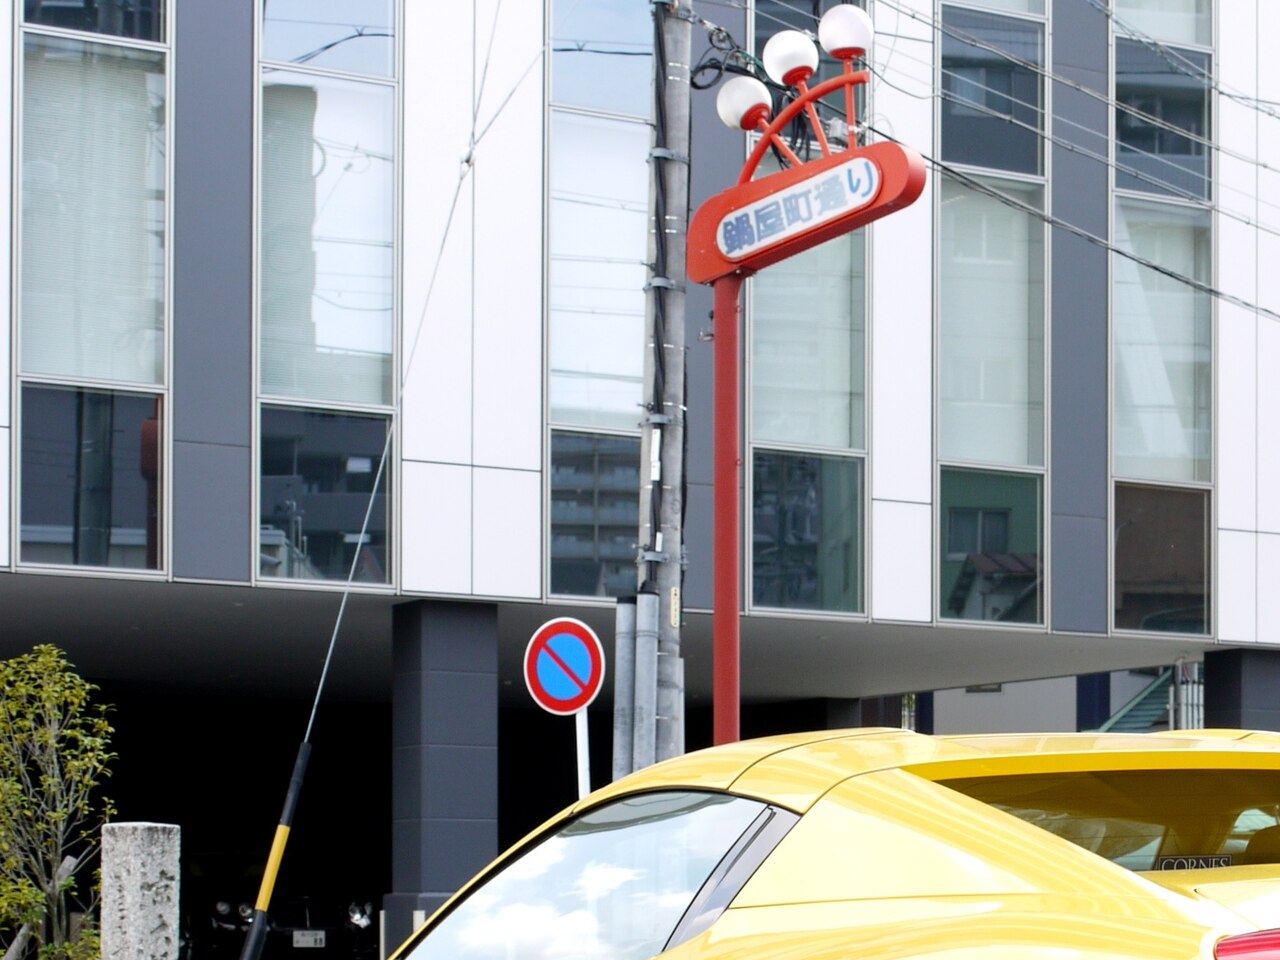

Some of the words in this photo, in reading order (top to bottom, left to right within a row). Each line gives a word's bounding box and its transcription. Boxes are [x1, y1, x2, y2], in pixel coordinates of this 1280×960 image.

[722, 161, 874, 255] 鍋屋町通り
